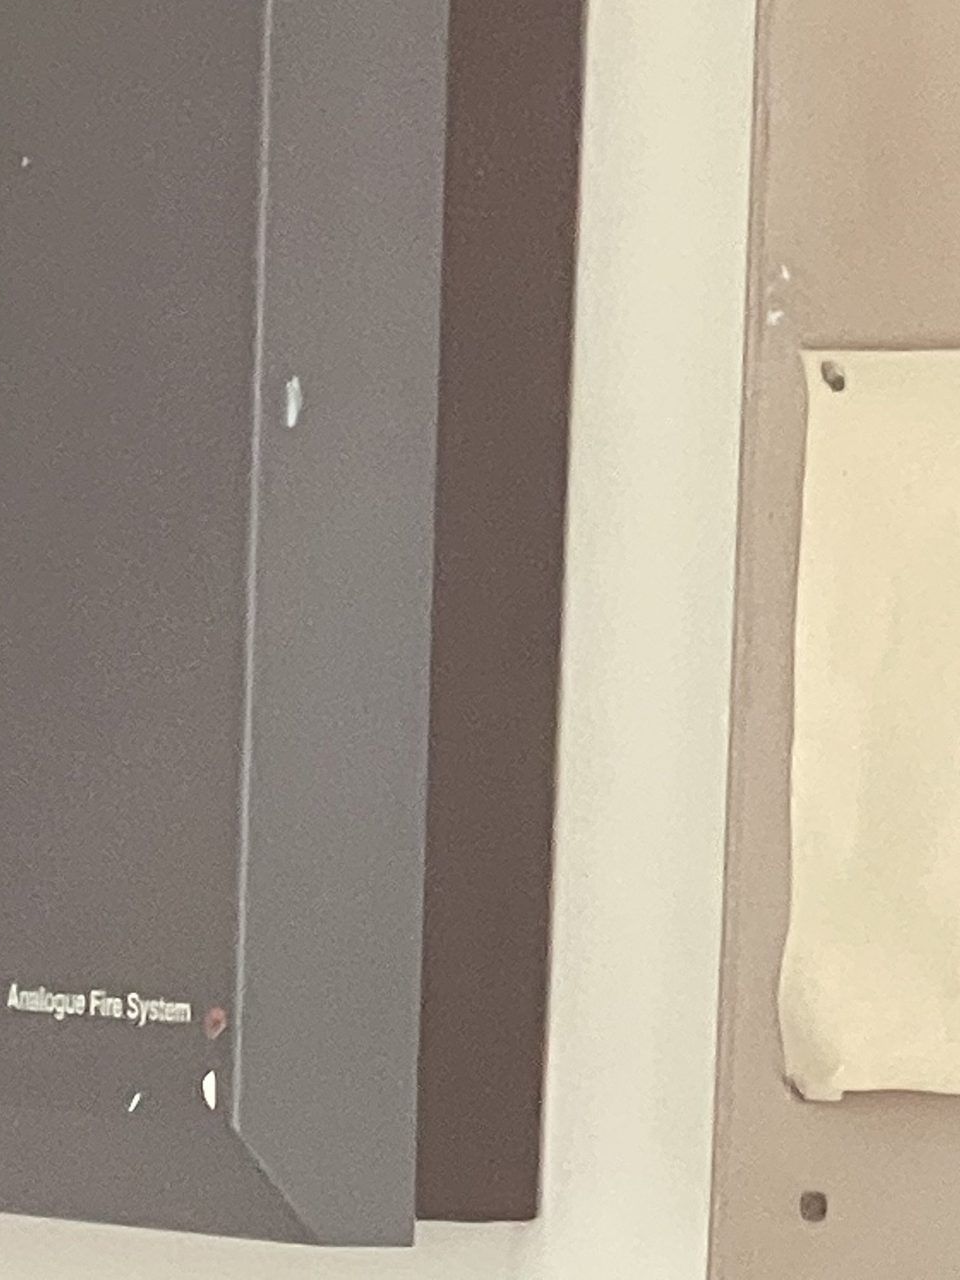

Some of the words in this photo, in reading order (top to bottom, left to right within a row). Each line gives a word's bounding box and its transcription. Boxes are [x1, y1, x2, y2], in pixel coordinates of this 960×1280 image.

[7, 983, 86, 1020] Analogue
[90, 989, 123, 1018] Fire
[126, 992, 191, 1027] System
